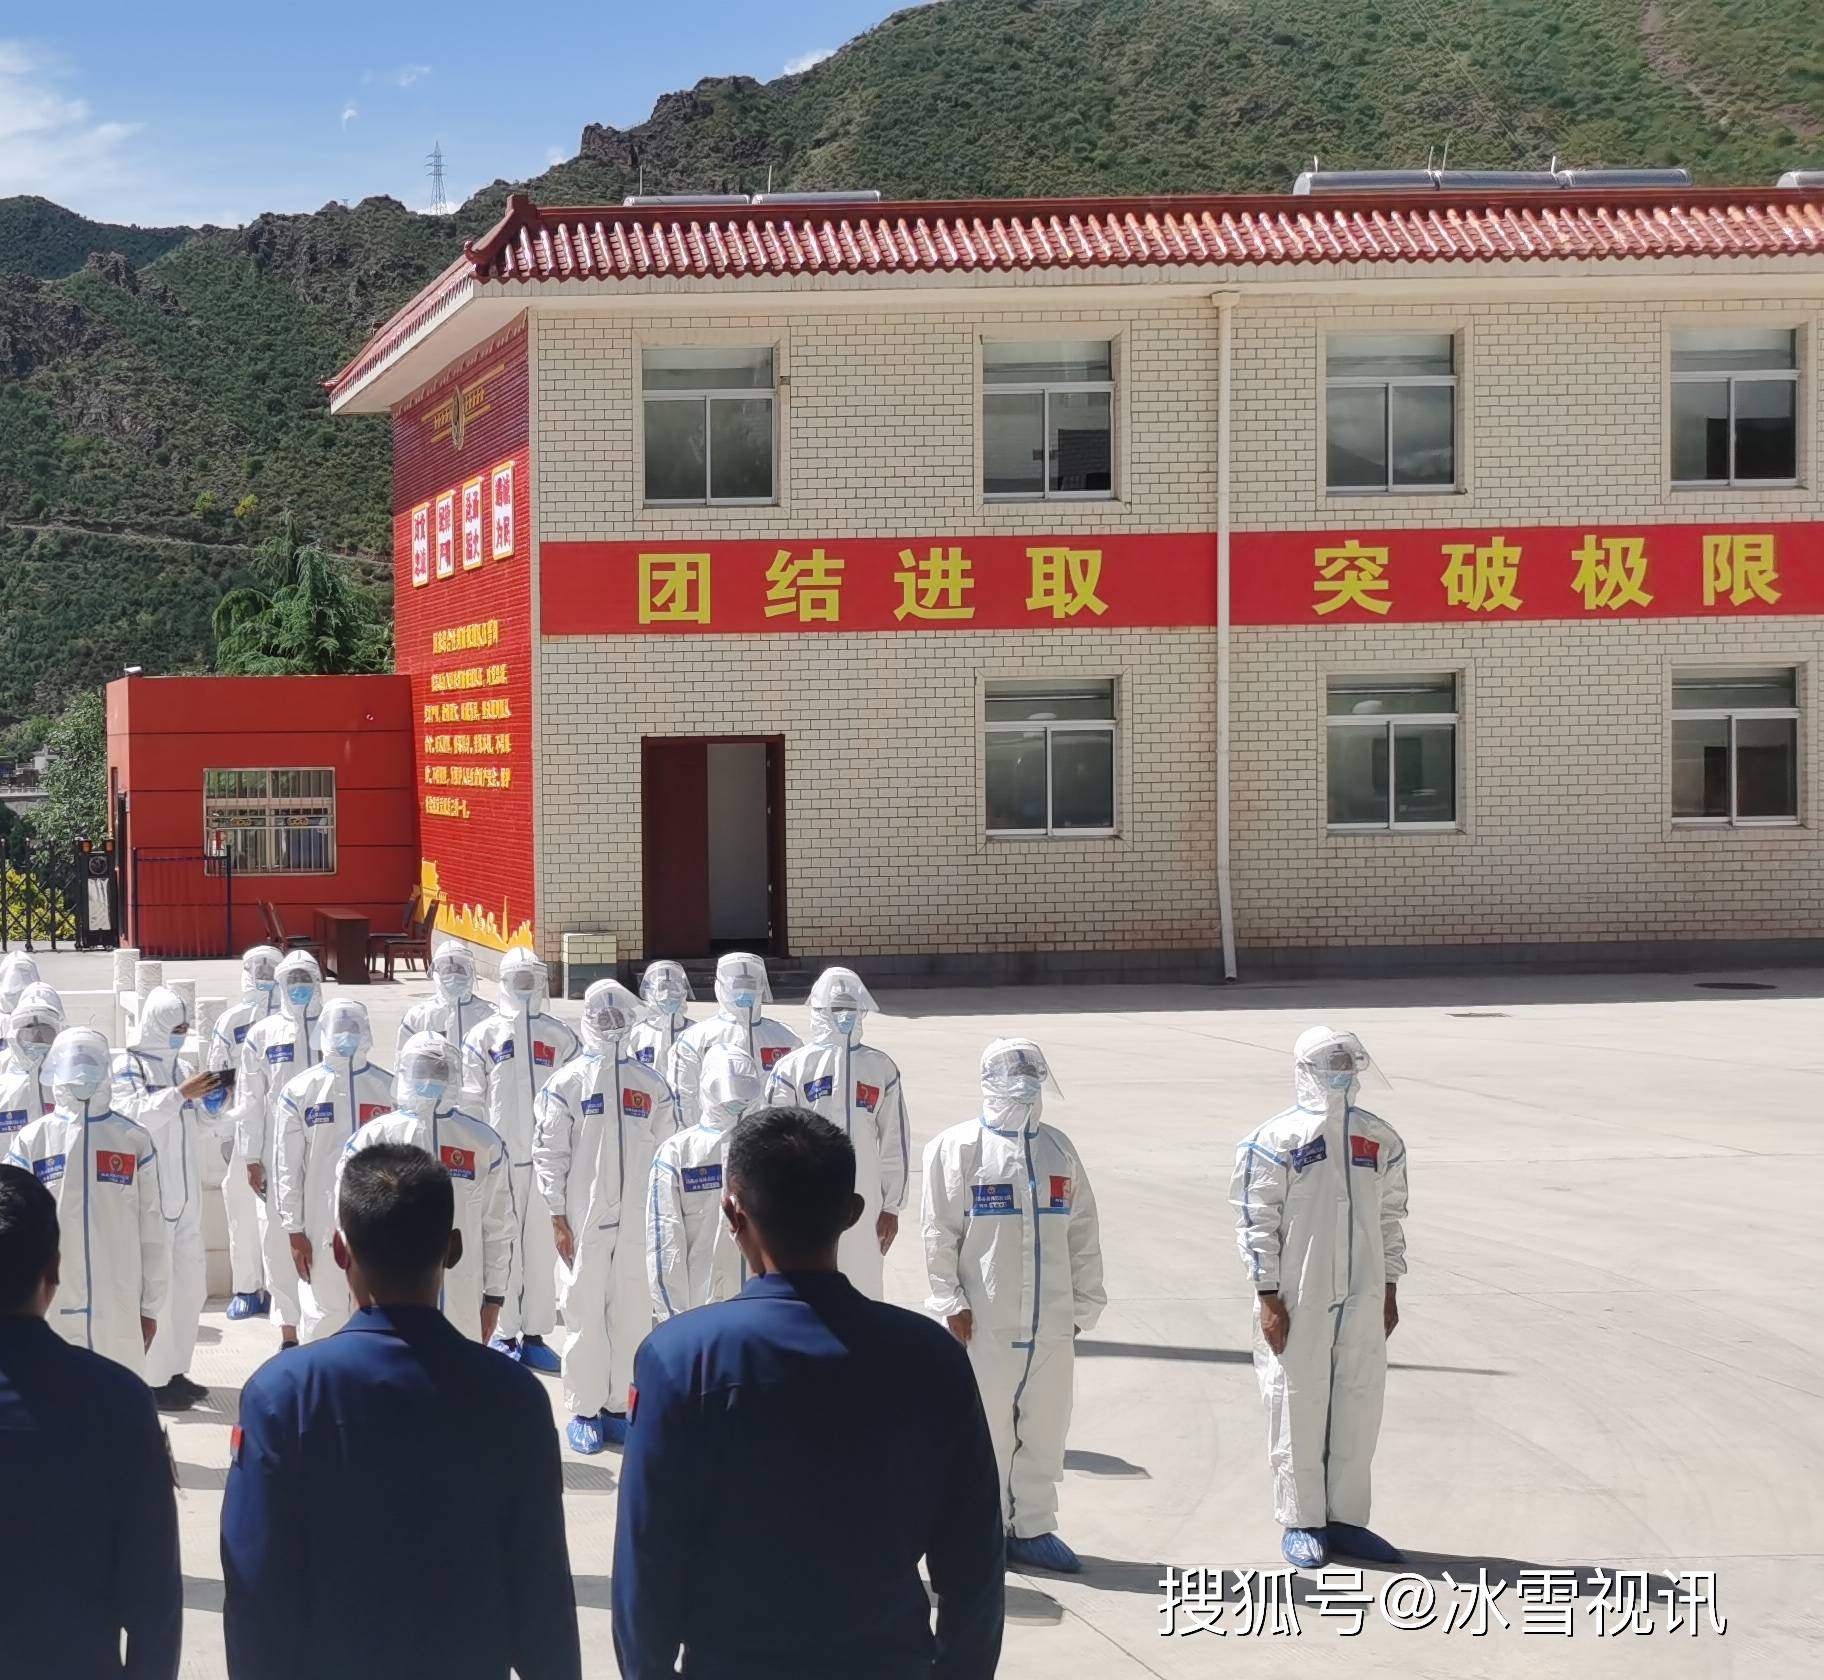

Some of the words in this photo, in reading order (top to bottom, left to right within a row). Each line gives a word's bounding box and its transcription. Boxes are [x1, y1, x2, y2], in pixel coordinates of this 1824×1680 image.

[638, 547, 1107, 625] 团结进取
[1314, 534, 1780, 615] 突破极限
